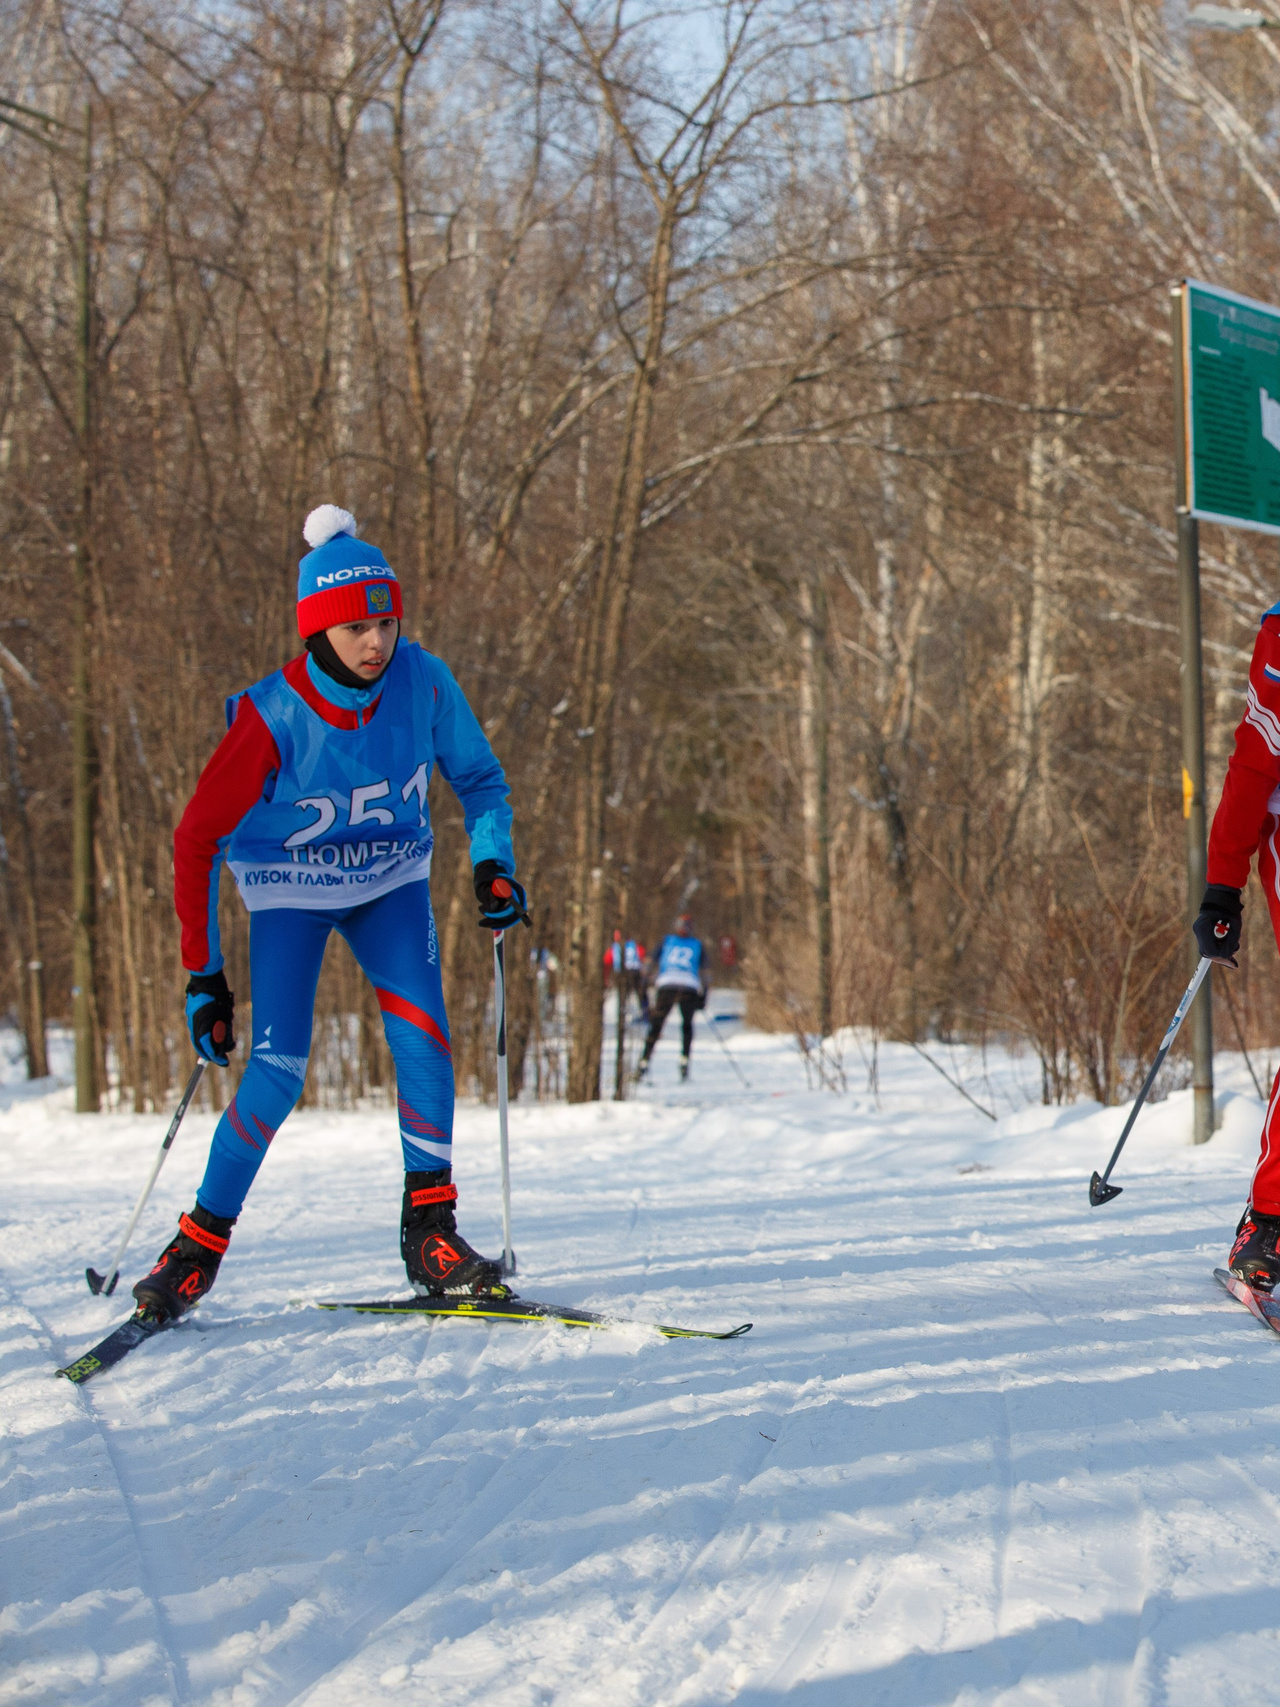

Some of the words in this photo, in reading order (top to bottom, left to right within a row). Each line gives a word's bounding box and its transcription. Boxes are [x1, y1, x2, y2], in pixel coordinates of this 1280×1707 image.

[283, 760, 430, 848] 251
[244, 870, 293, 887] КУБОК
[297, 872, 345, 887] ГЛАВЫ
[668, 945, 694, 968] 42
[195, 1231, 228, 1252] ROSSIGNO
